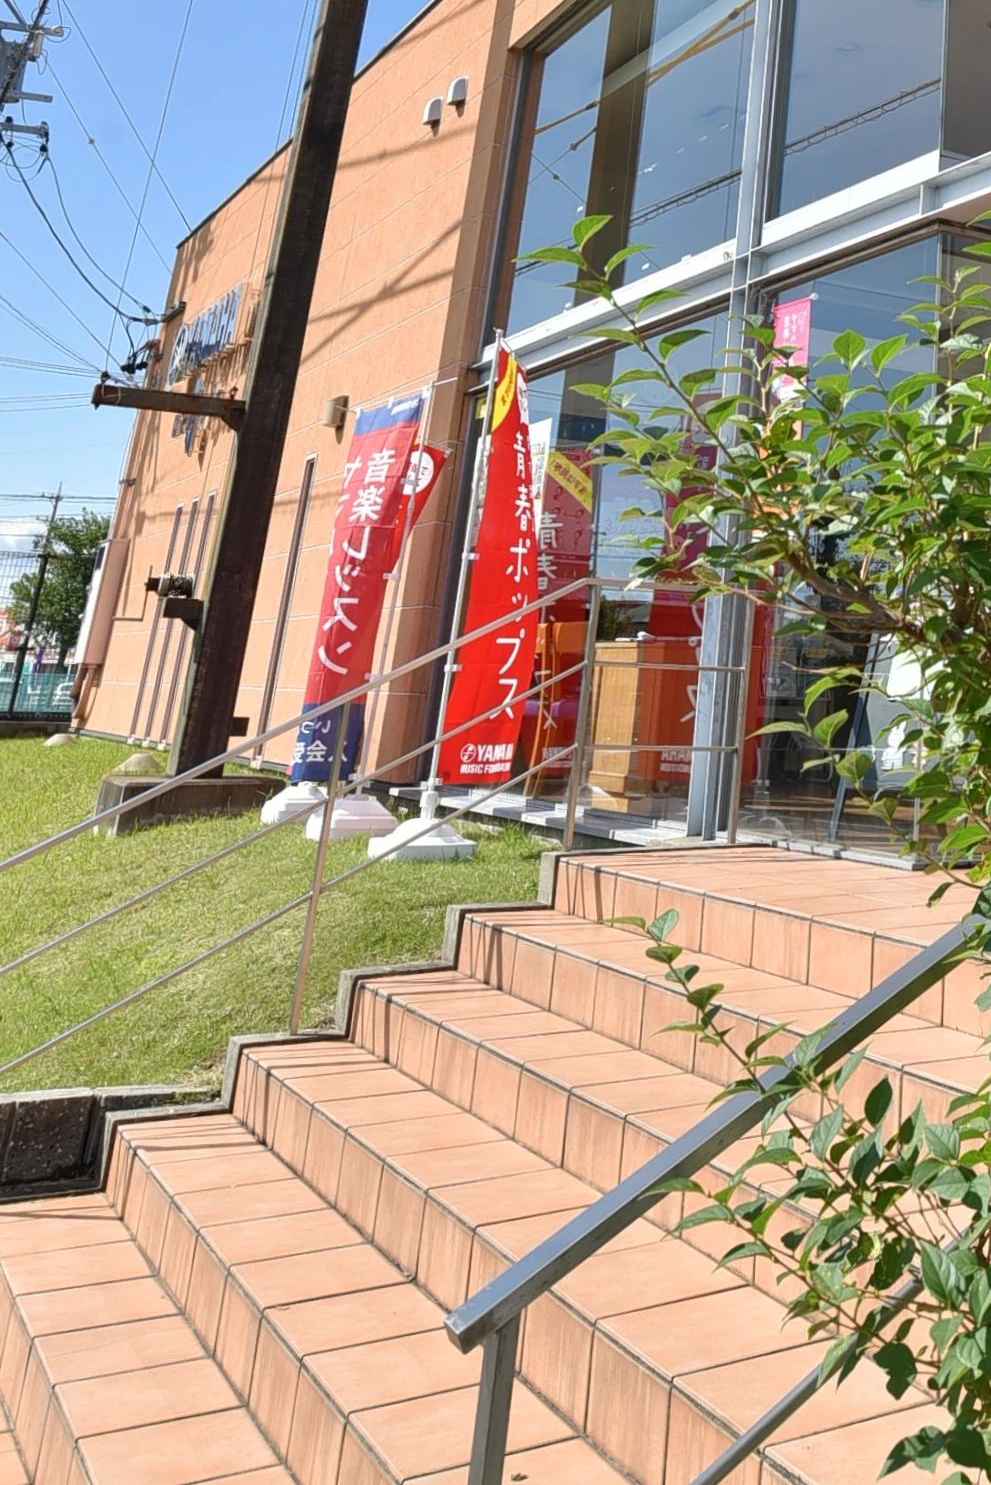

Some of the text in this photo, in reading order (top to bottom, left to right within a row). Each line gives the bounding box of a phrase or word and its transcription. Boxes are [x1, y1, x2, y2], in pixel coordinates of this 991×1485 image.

[488, 431, 532, 721] 青春ポップス
